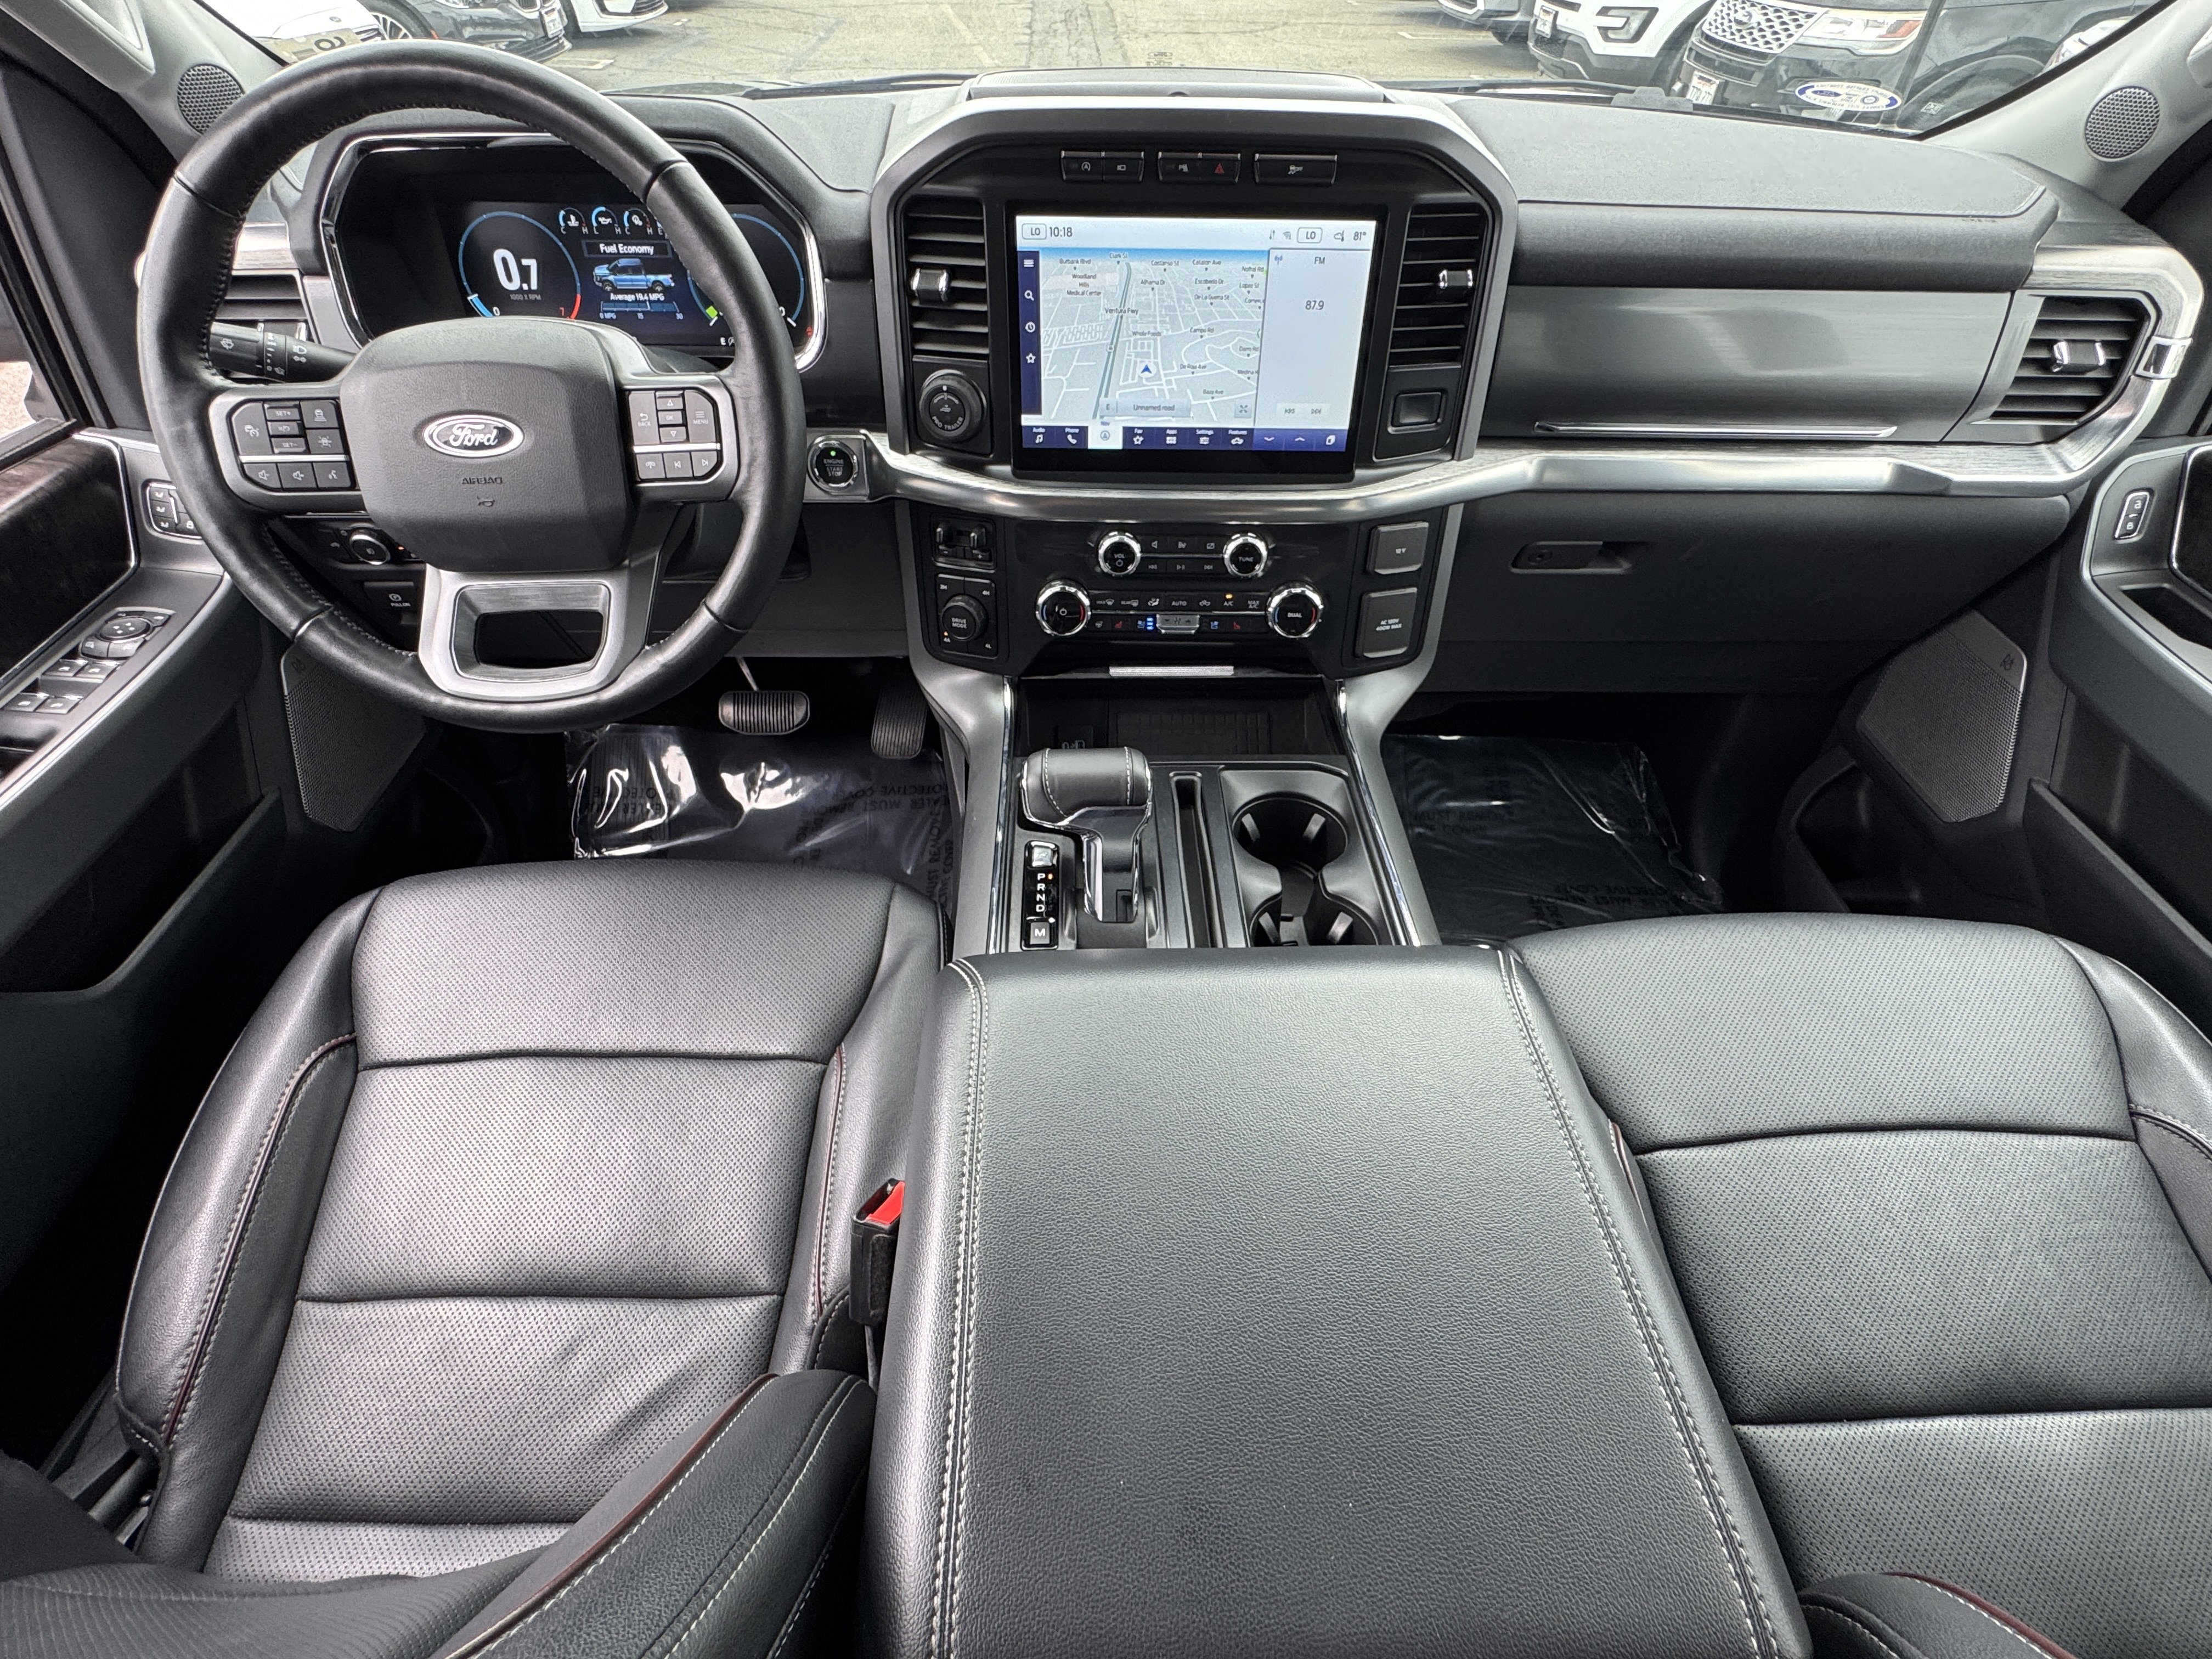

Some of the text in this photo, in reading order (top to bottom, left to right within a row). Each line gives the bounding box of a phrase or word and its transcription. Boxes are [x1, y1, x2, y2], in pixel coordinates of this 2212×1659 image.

[1030, 227, 1041, 236] LO
[1049, 227, 1073, 238] 10:18
[1306, 231, 1316, 240] LO
[599, 244, 654, 256] Fuel Economy
[1314, 256, 1325, 264] FM
[494, 249, 538, 291] 0.7
[610, 292, 635, 302] Average
[1305, 300, 1324, 310] 87.9
[449, 424, 498, 446] Ford
[461, 477, 503, 485] AIRBAG
[1036, 893, 1045, 901] N
[1036, 904, 1045, 912] D
[1035, 928, 1046, 936] M
